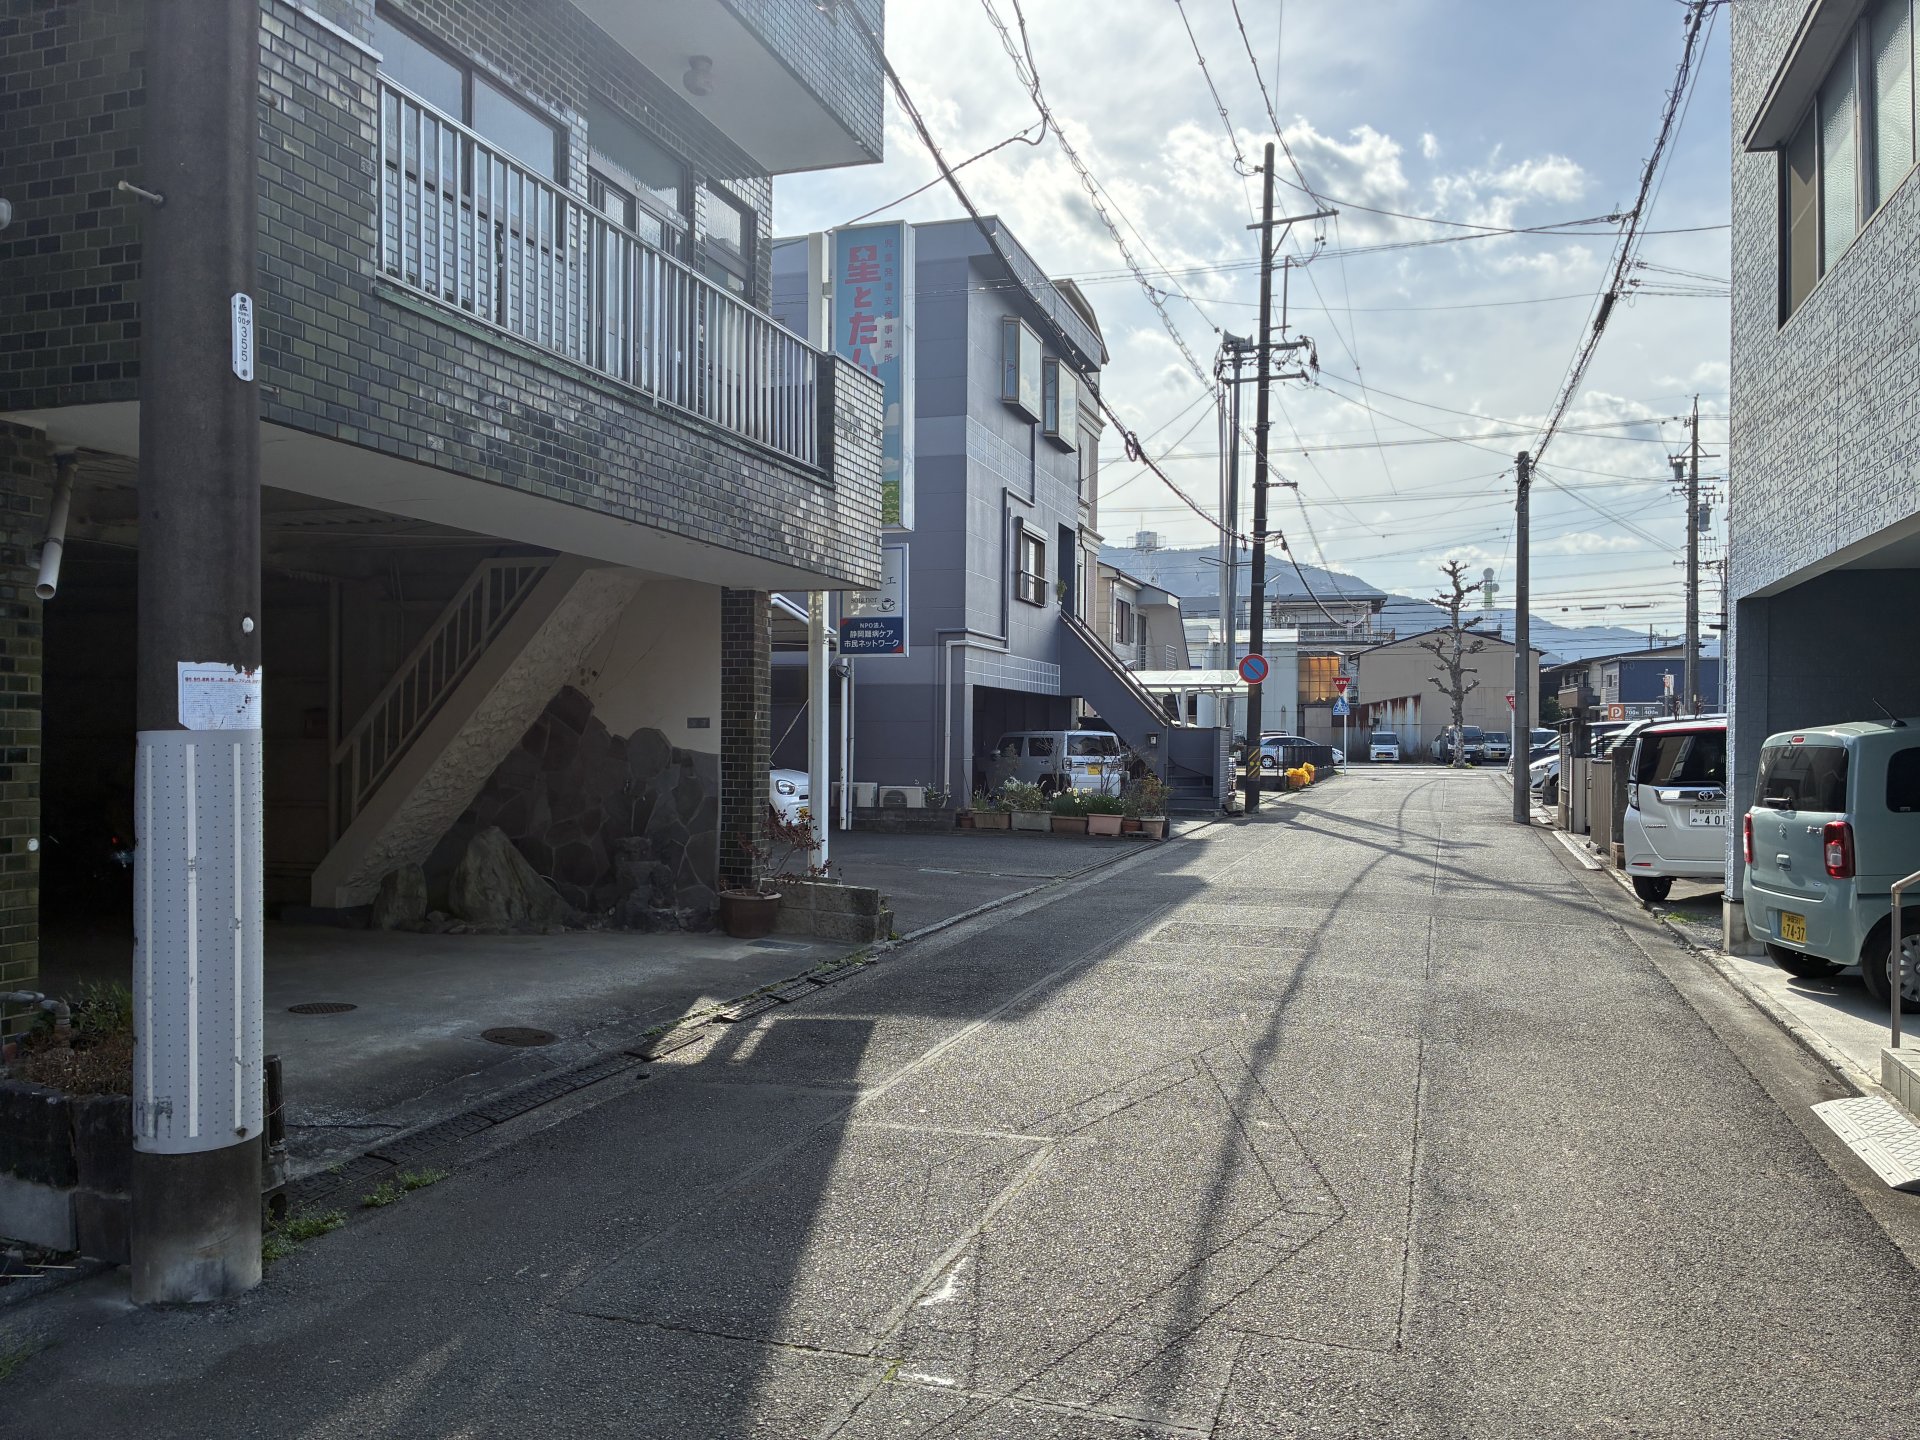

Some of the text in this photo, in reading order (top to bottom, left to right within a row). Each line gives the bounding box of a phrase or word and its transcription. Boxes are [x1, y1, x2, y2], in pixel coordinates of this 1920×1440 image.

[849, 630, 894, 638] 静岡難病ケア
[844, 640, 900, 648] 市民ネットワーク
